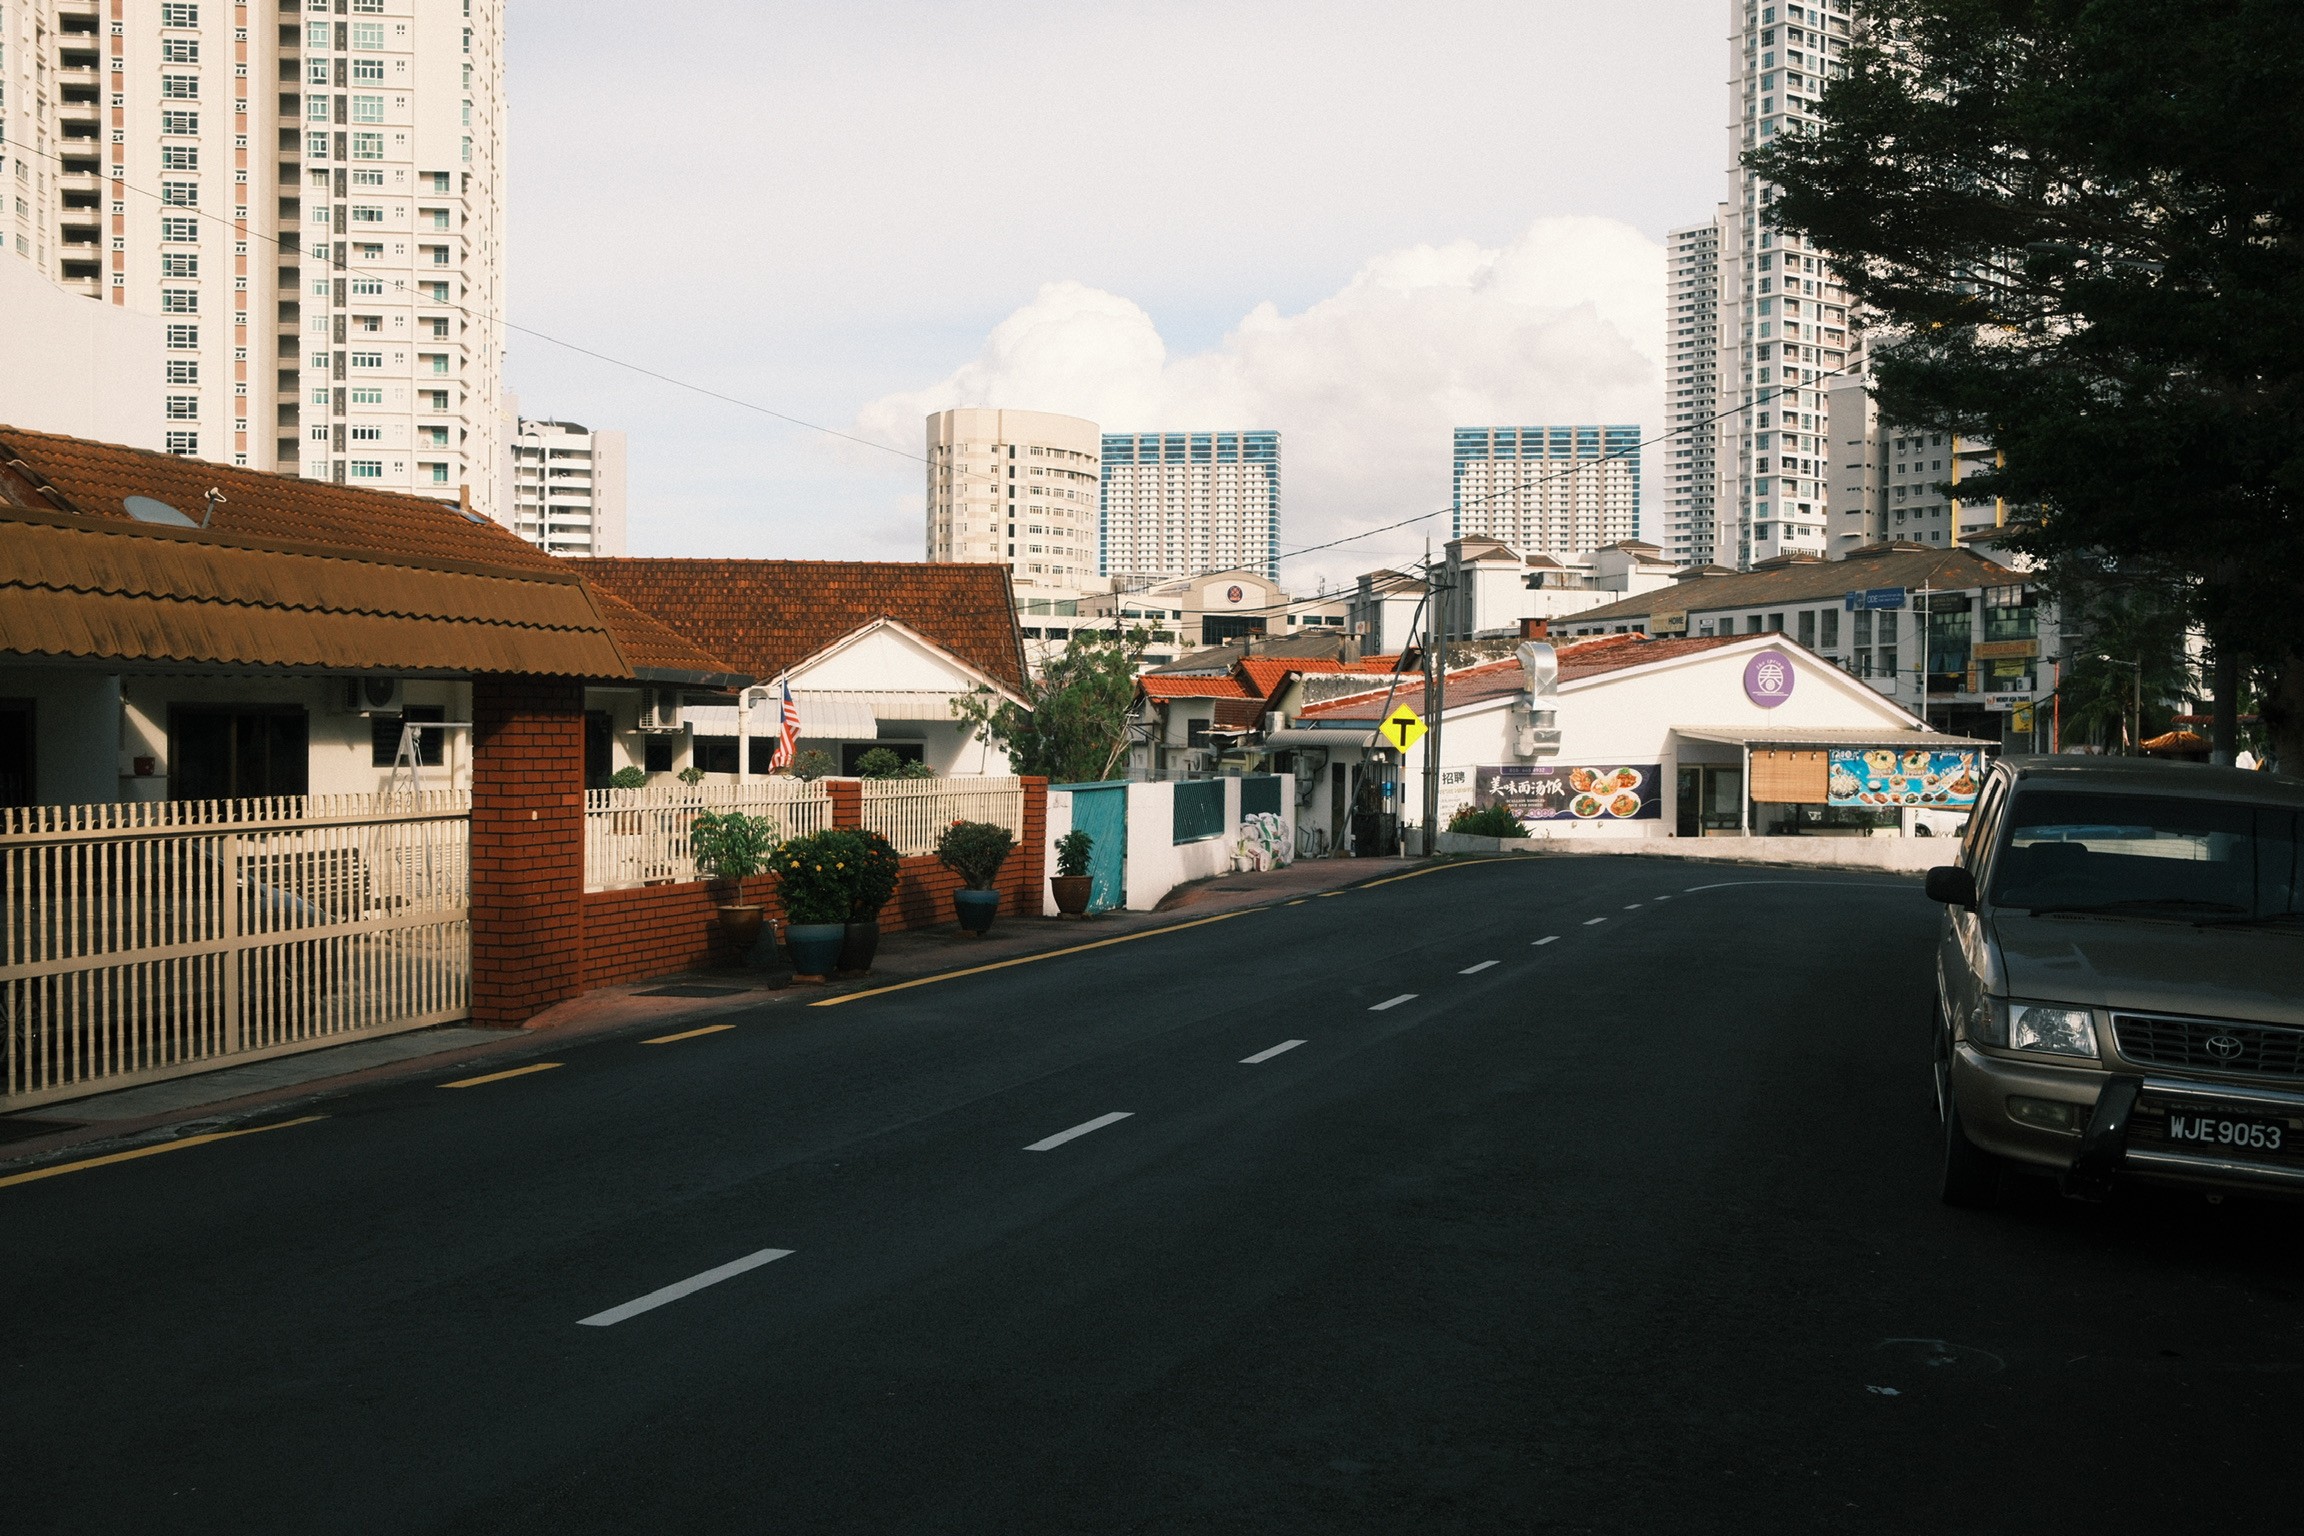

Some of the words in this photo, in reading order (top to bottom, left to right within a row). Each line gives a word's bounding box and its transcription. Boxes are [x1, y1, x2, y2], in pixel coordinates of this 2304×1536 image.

[1668, 616, 1684, 625] HOME
[1442, 771, 1466, 785] 招聘
[1489, 775, 1566, 797] 美味面汤饭
